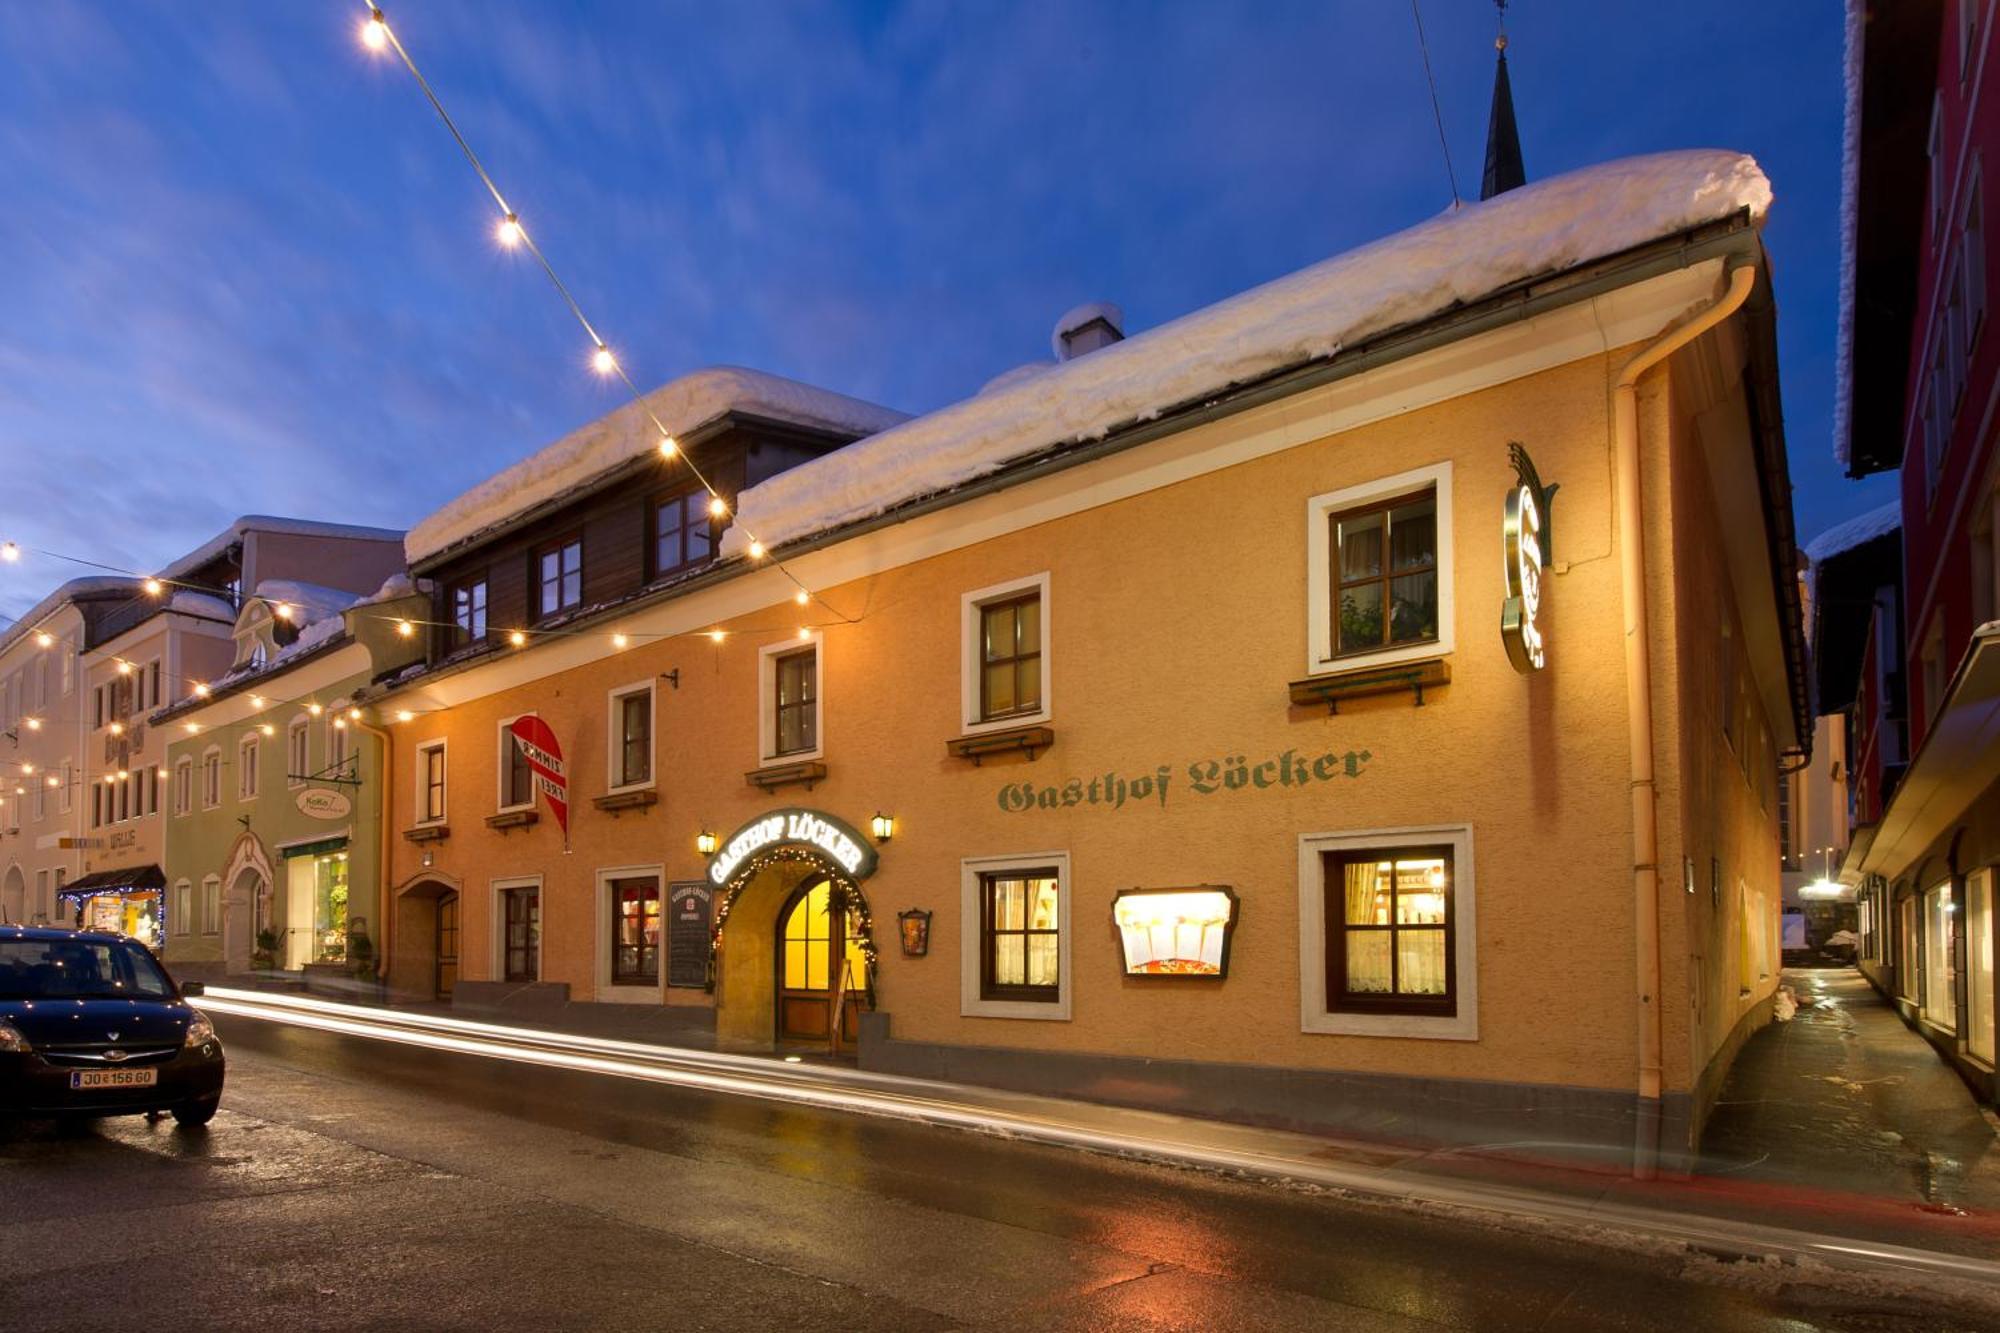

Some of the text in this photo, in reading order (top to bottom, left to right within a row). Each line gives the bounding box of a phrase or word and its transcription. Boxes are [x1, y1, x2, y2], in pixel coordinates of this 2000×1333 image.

[996, 747, 1373, 813] Gasthof Löcker
[711, 812, 863, 884] GASTHOF LÖCKER
